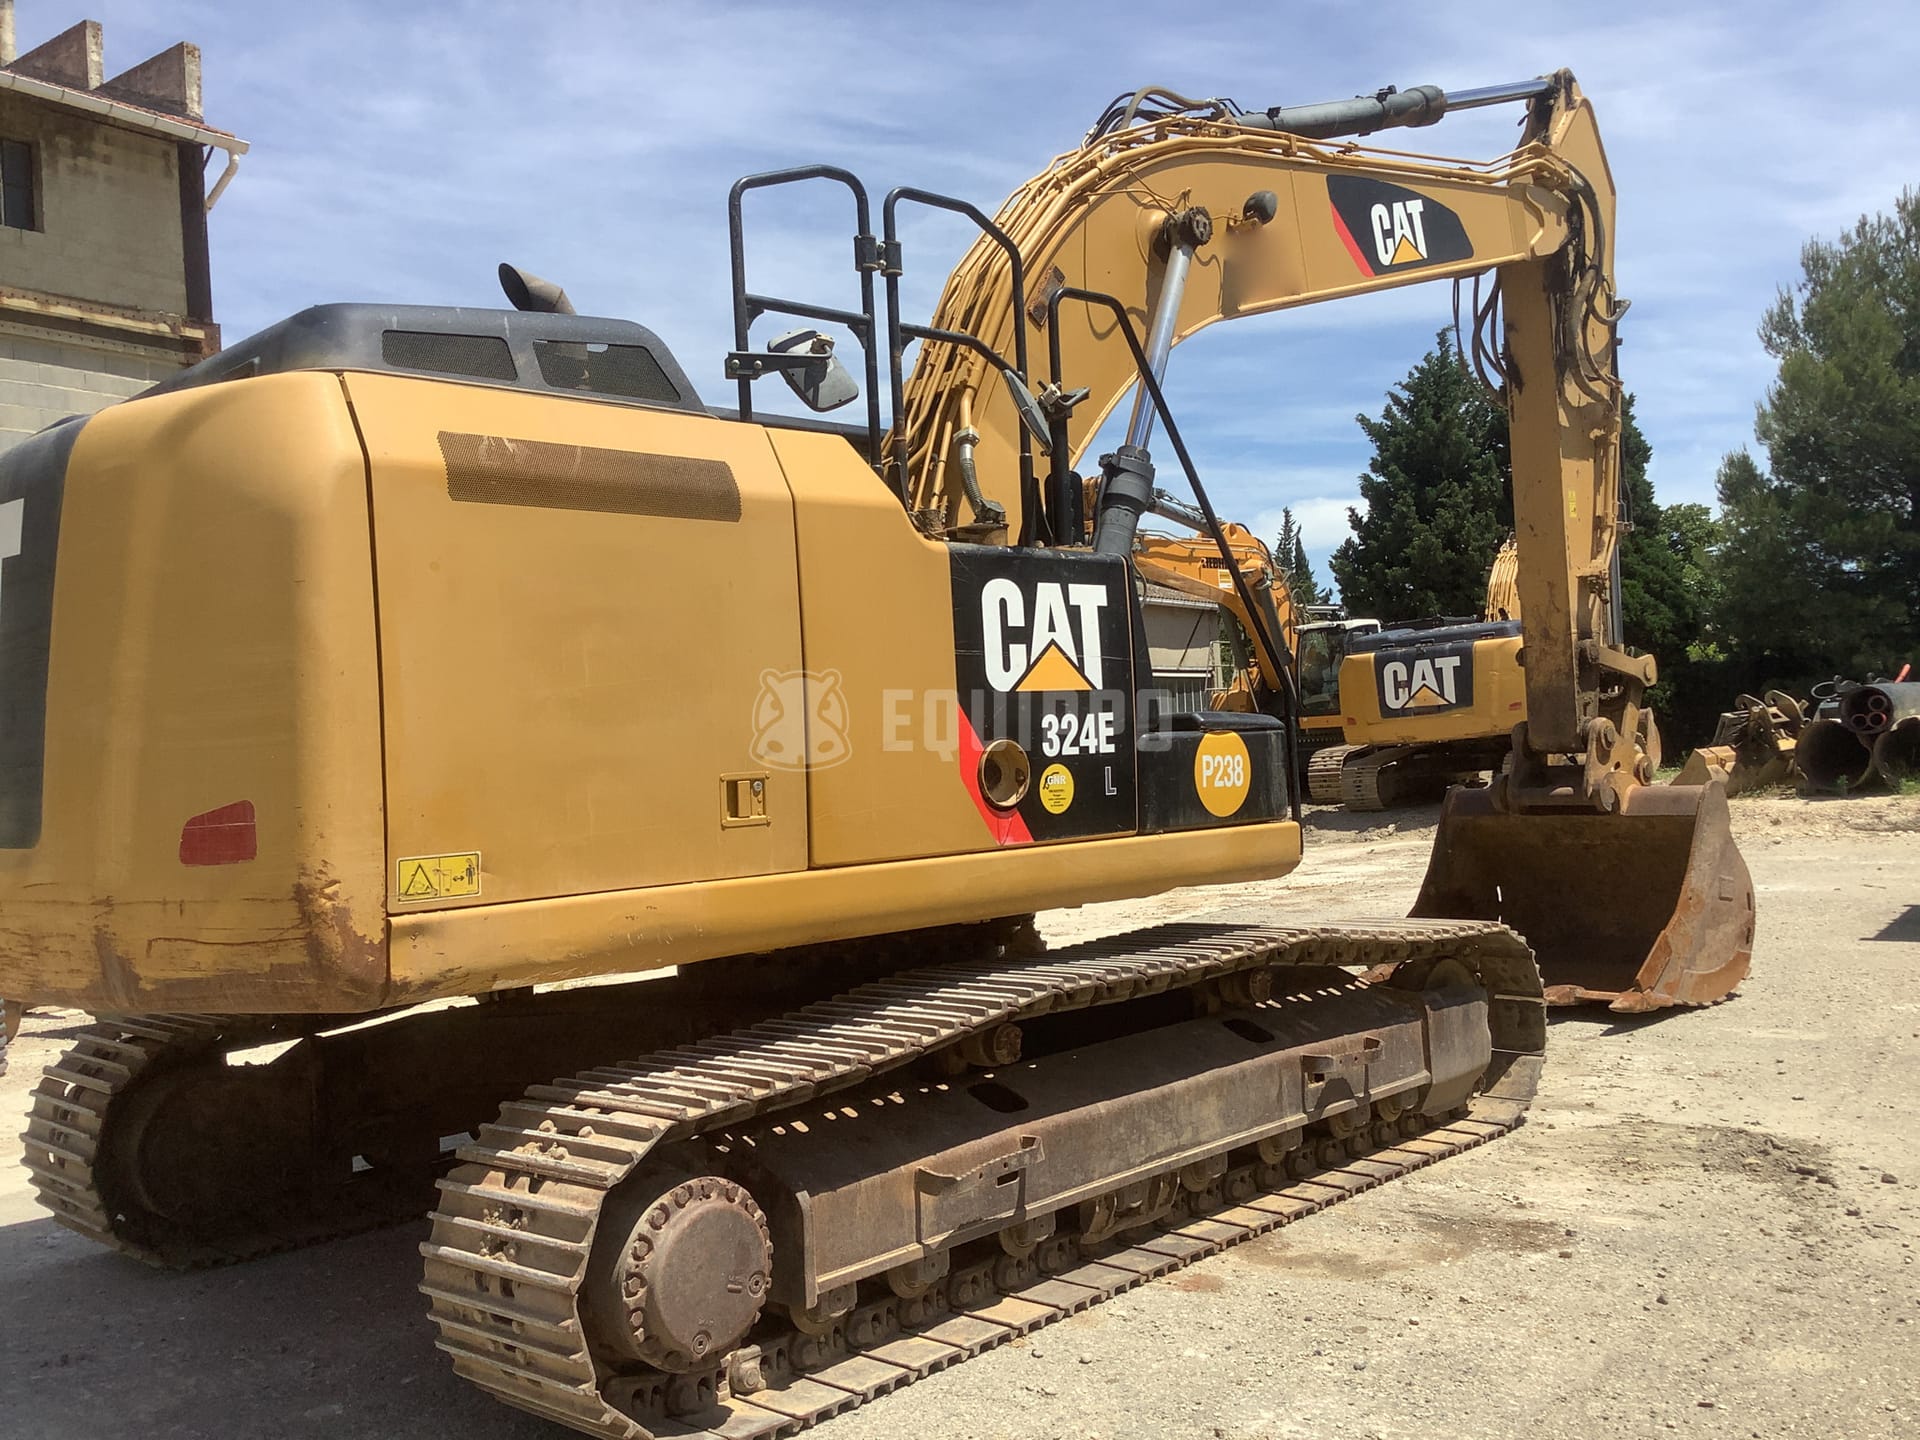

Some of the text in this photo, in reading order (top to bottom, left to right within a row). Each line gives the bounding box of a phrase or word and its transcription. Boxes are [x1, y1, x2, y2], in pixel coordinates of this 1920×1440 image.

[1371, 199, 1428, 266] CAT
[981, 578, 1108, 692] CAT
[1383, 655, 1461, 710] CAT
[1041, 711, 1116, 757] 324E
[1104, 766, 1117, 796] L
[1202, 754, 1244, 788] P238
